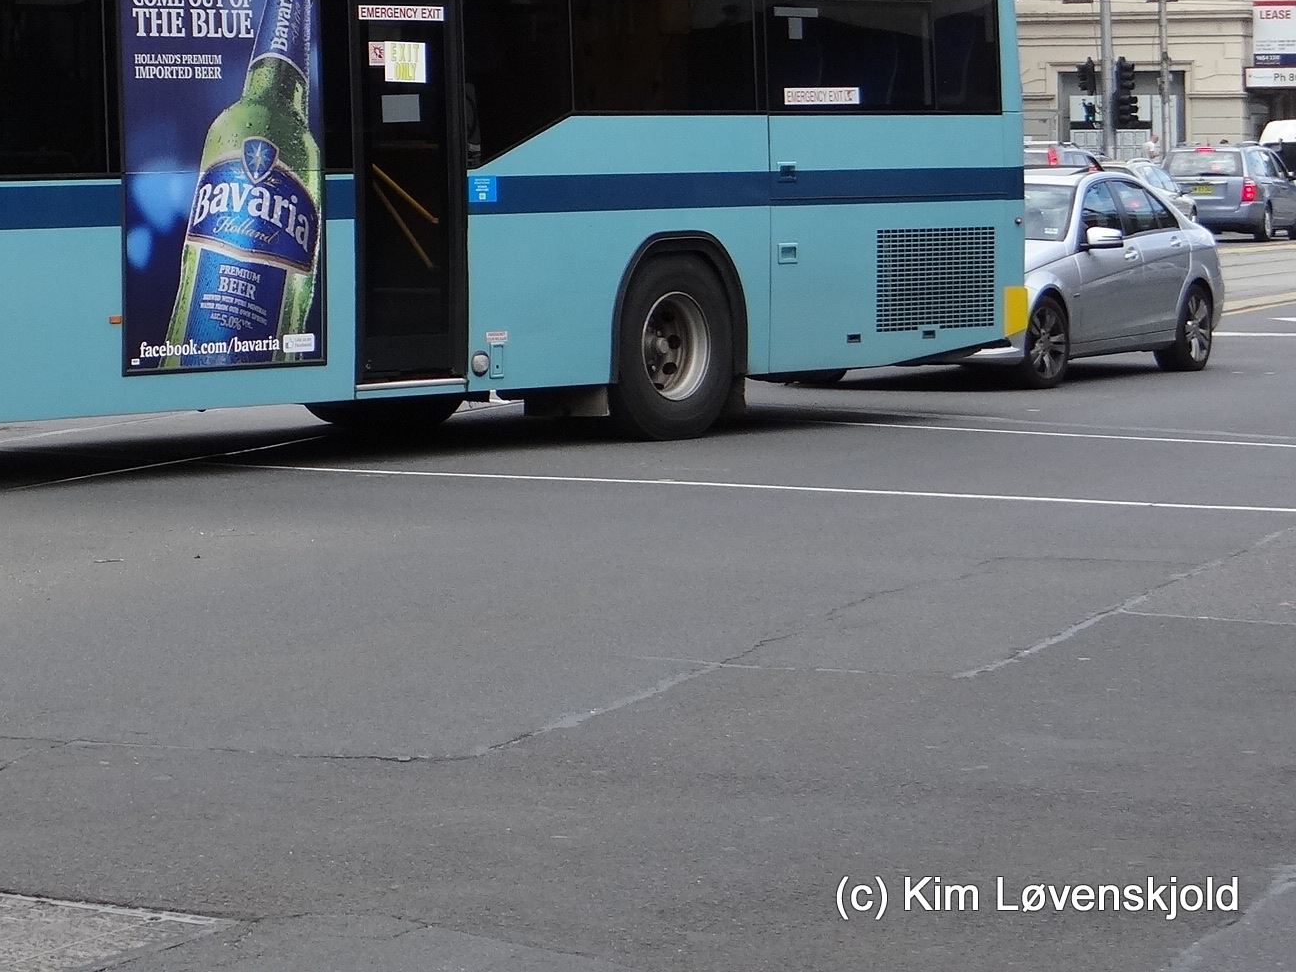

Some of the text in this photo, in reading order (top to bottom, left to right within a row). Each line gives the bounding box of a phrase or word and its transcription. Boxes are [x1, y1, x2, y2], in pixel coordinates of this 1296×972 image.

[361, 7, 441, 19] EMERGENCY EXIT
[1259, 10, 1291, 20] LEASE
[132, 8, 254, 38] THE BLUE
[134, 54, 222, 65] HOLLAND'S PREMIUM
[391, 43, 420, 62] EXIT
[135, 66, 222, 79] IMPORTED BEER
[394, 62, 417, 81] ONLY
[1273, 73, 1286, 82] Ph
[1288, 73, 1296, 82] 8
[787, 90, 843, 102] EMERGENCY EXIT
[193, 181, 310, 253] Bavaria
[212, 215, 280, 245] Holland
[219, 264, 261, 284] PREMIUM
[218, 276, 256, 300] BEER
[140, 337, 280, 358] facebook.com/bavaria
